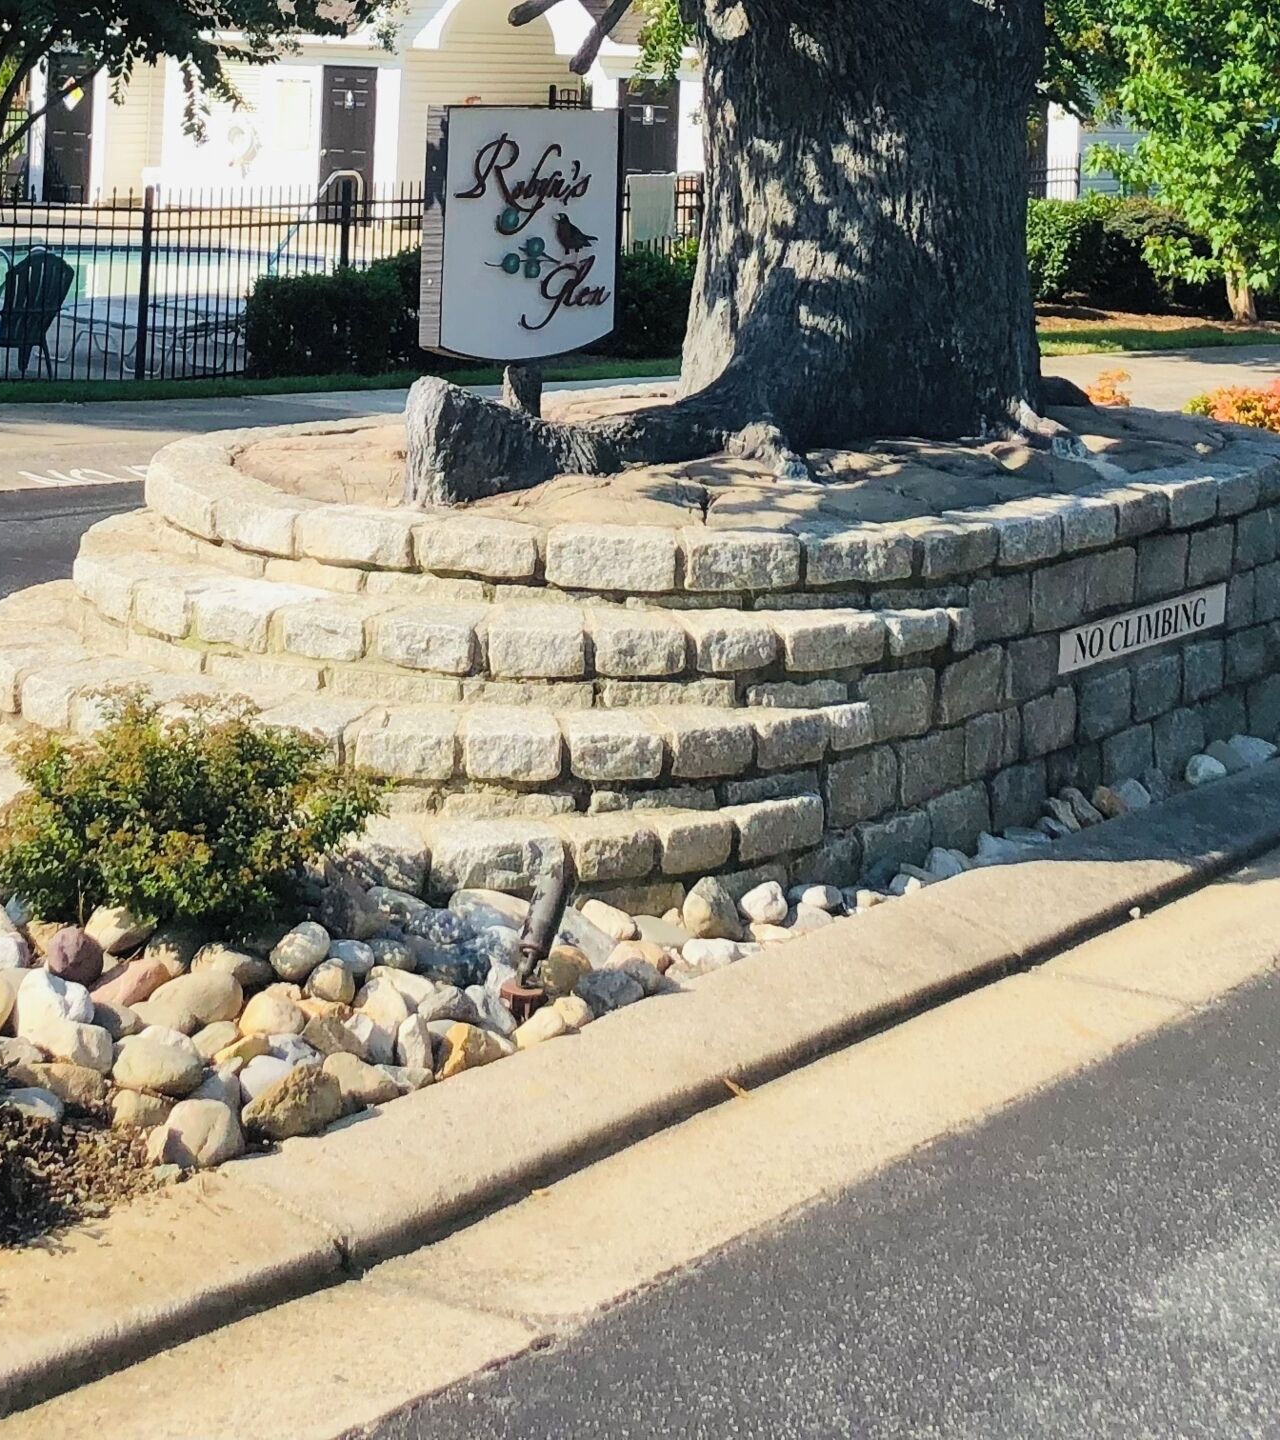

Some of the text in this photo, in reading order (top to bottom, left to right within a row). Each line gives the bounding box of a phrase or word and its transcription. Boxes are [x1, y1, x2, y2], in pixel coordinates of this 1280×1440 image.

[519, 255, 611, 330] Glen
[1073, 597, 1207, 664] NO CLIMBING
